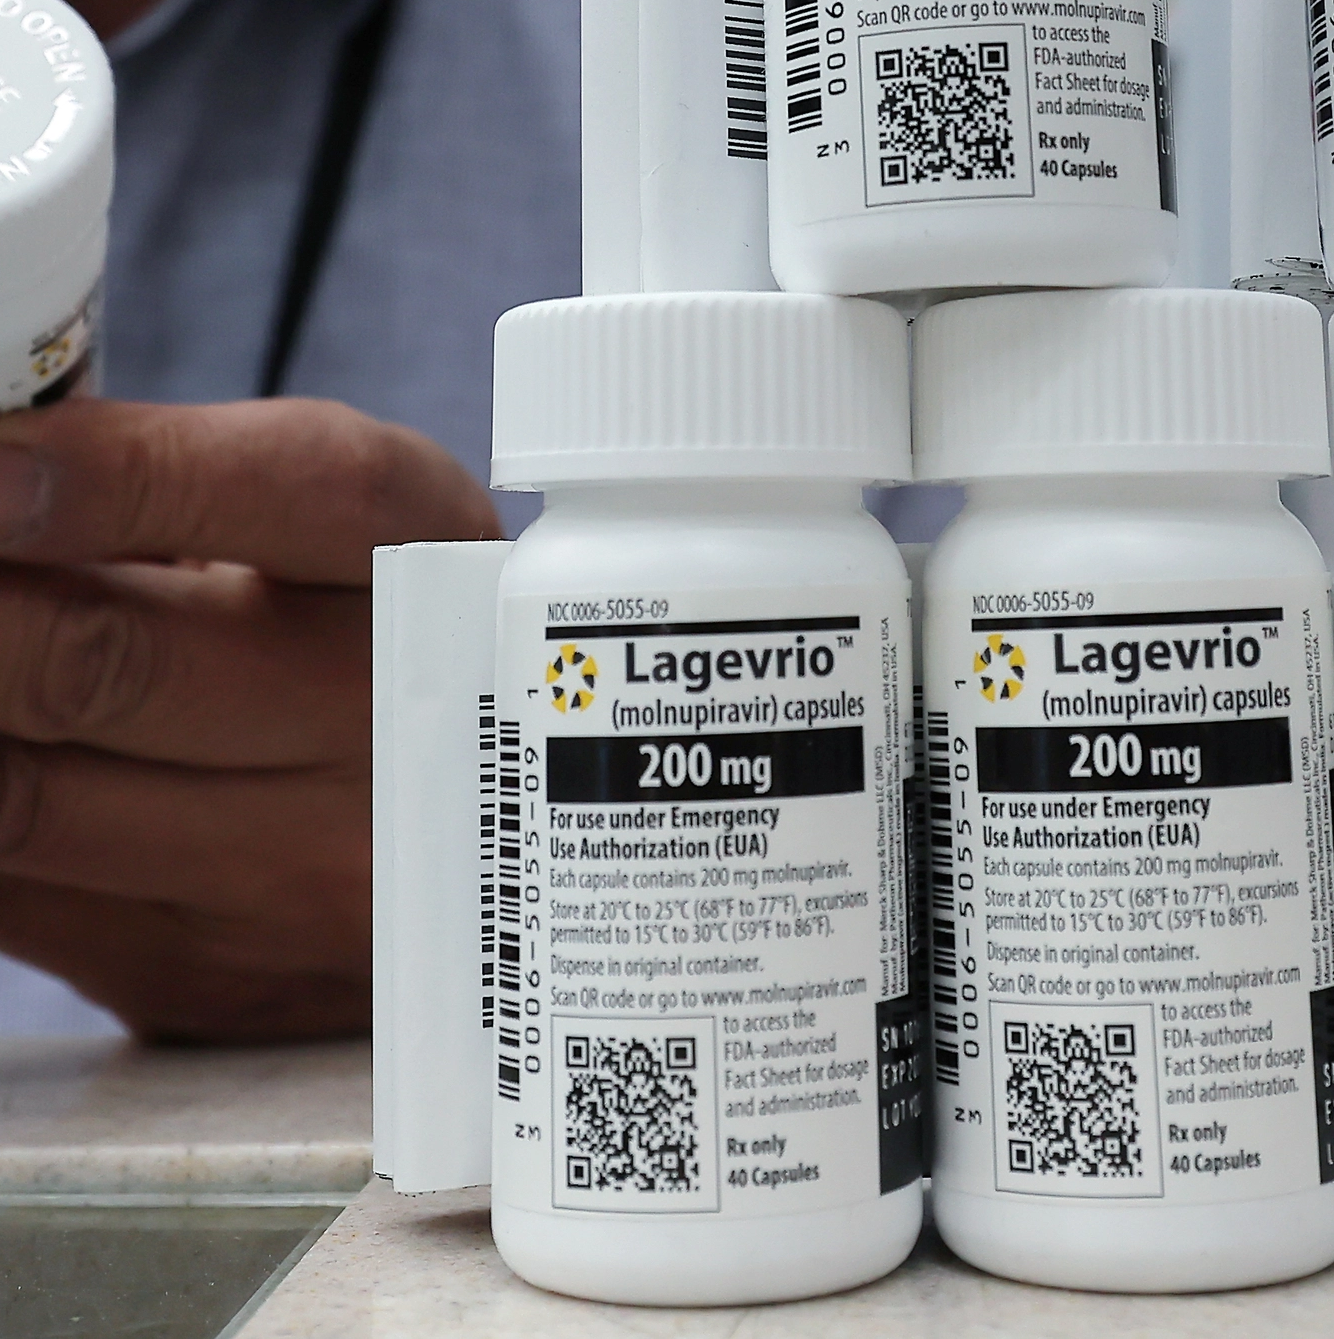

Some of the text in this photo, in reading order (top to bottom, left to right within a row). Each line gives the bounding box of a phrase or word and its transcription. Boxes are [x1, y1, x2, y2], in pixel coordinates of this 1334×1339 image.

[547, 599, 668, 621] NDC 0006-5055-09
[973, 592, 1094, 614] NDC 0006-5055-09
[612, 691, 864, 731] (molnupiravir) capsules
[1042, 681, 1291, 721] (molnupiravir) capsules
[638, 744, 772, 794] 200 mg
[1069, 734, 1202, 784] 200 mg
[550, 805, 779, 829] For use under Emergency
[981, 793, 1211, 819] For use under Emergency
[550, 834, 767, 860] Use Authorization (EUA)
[982, 823, 1199, 849] Use Authorization (EUA)
